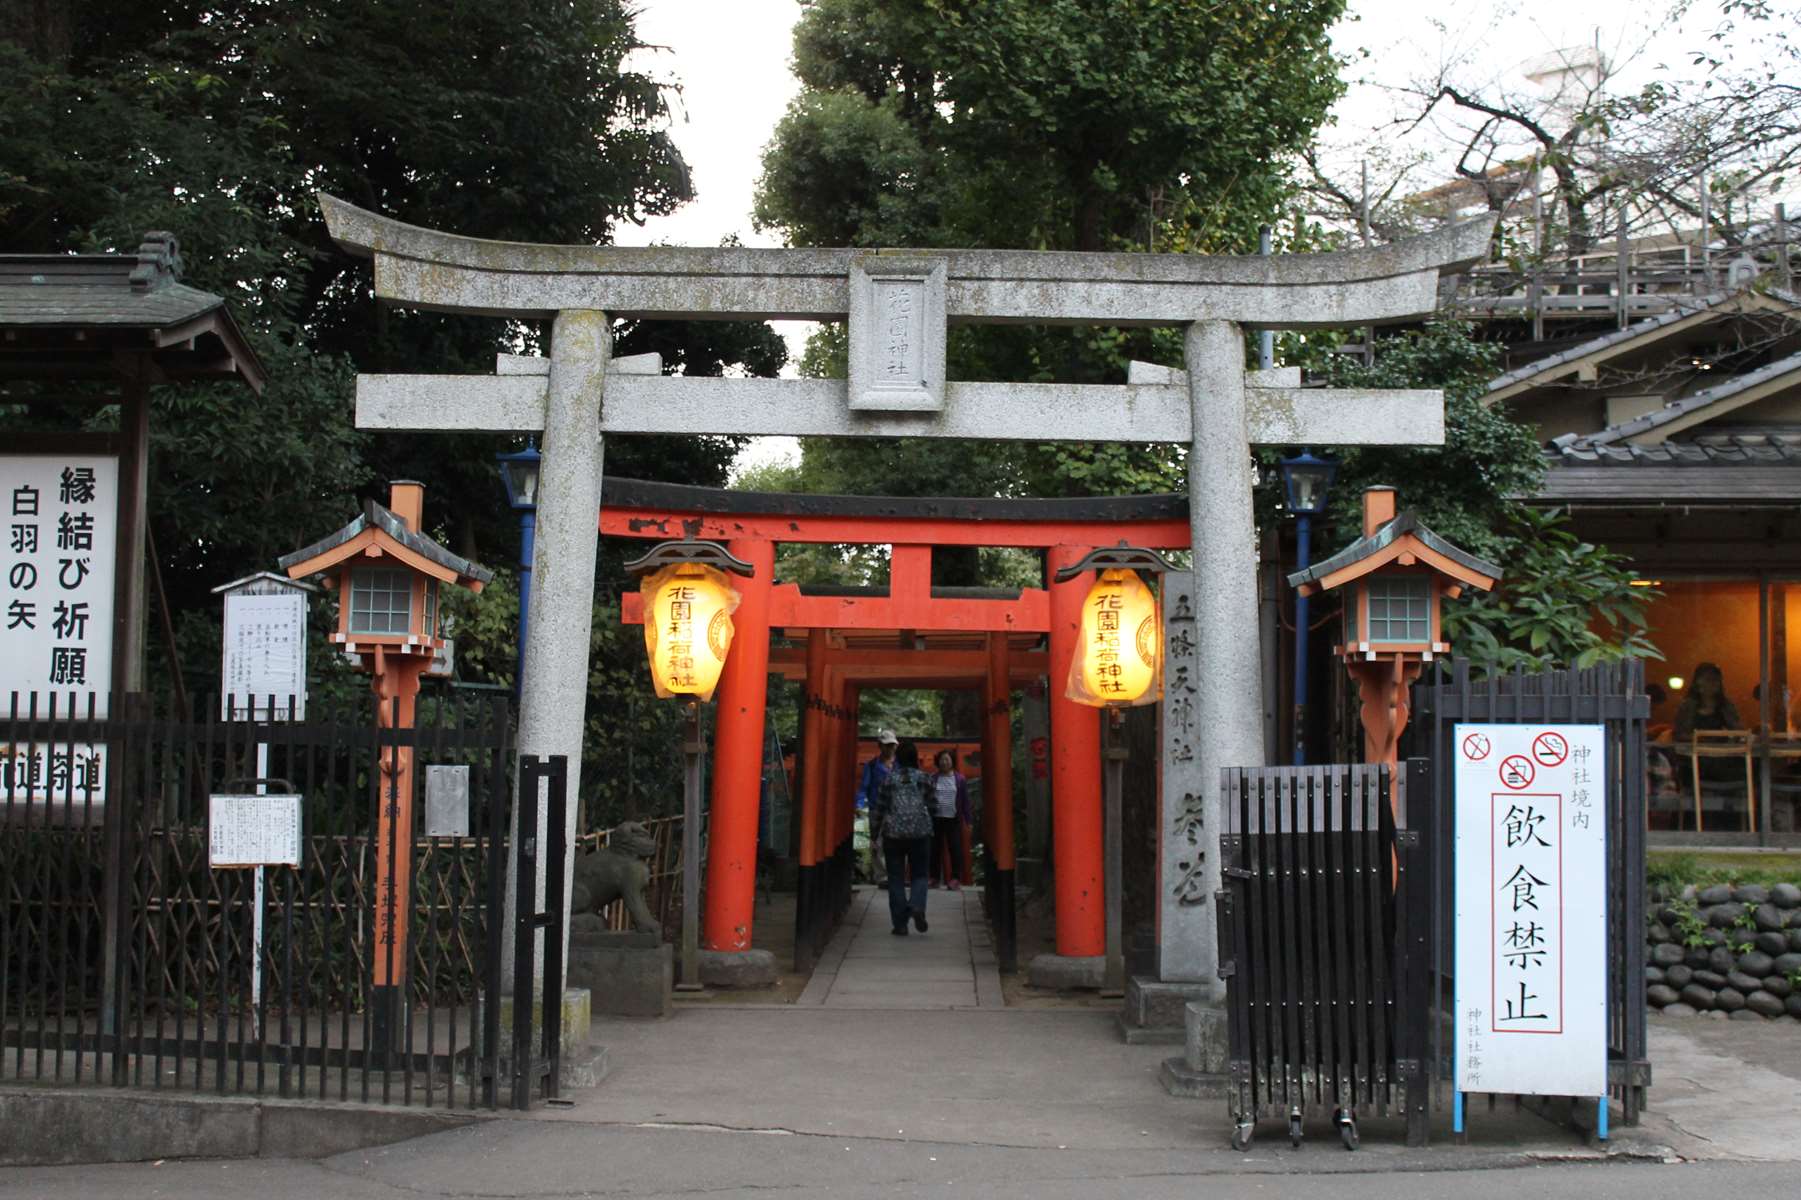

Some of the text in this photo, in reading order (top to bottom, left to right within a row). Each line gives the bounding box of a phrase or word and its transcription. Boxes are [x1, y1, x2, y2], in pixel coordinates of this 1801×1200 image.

[7, 484, 40, 630] 白羽の矢
[49, 466, 97, 686] 縁結び祈願
[1571, 744, 1592, 830] 神社境内
[1500, 804, 1553, 1022] 飲食禁止
